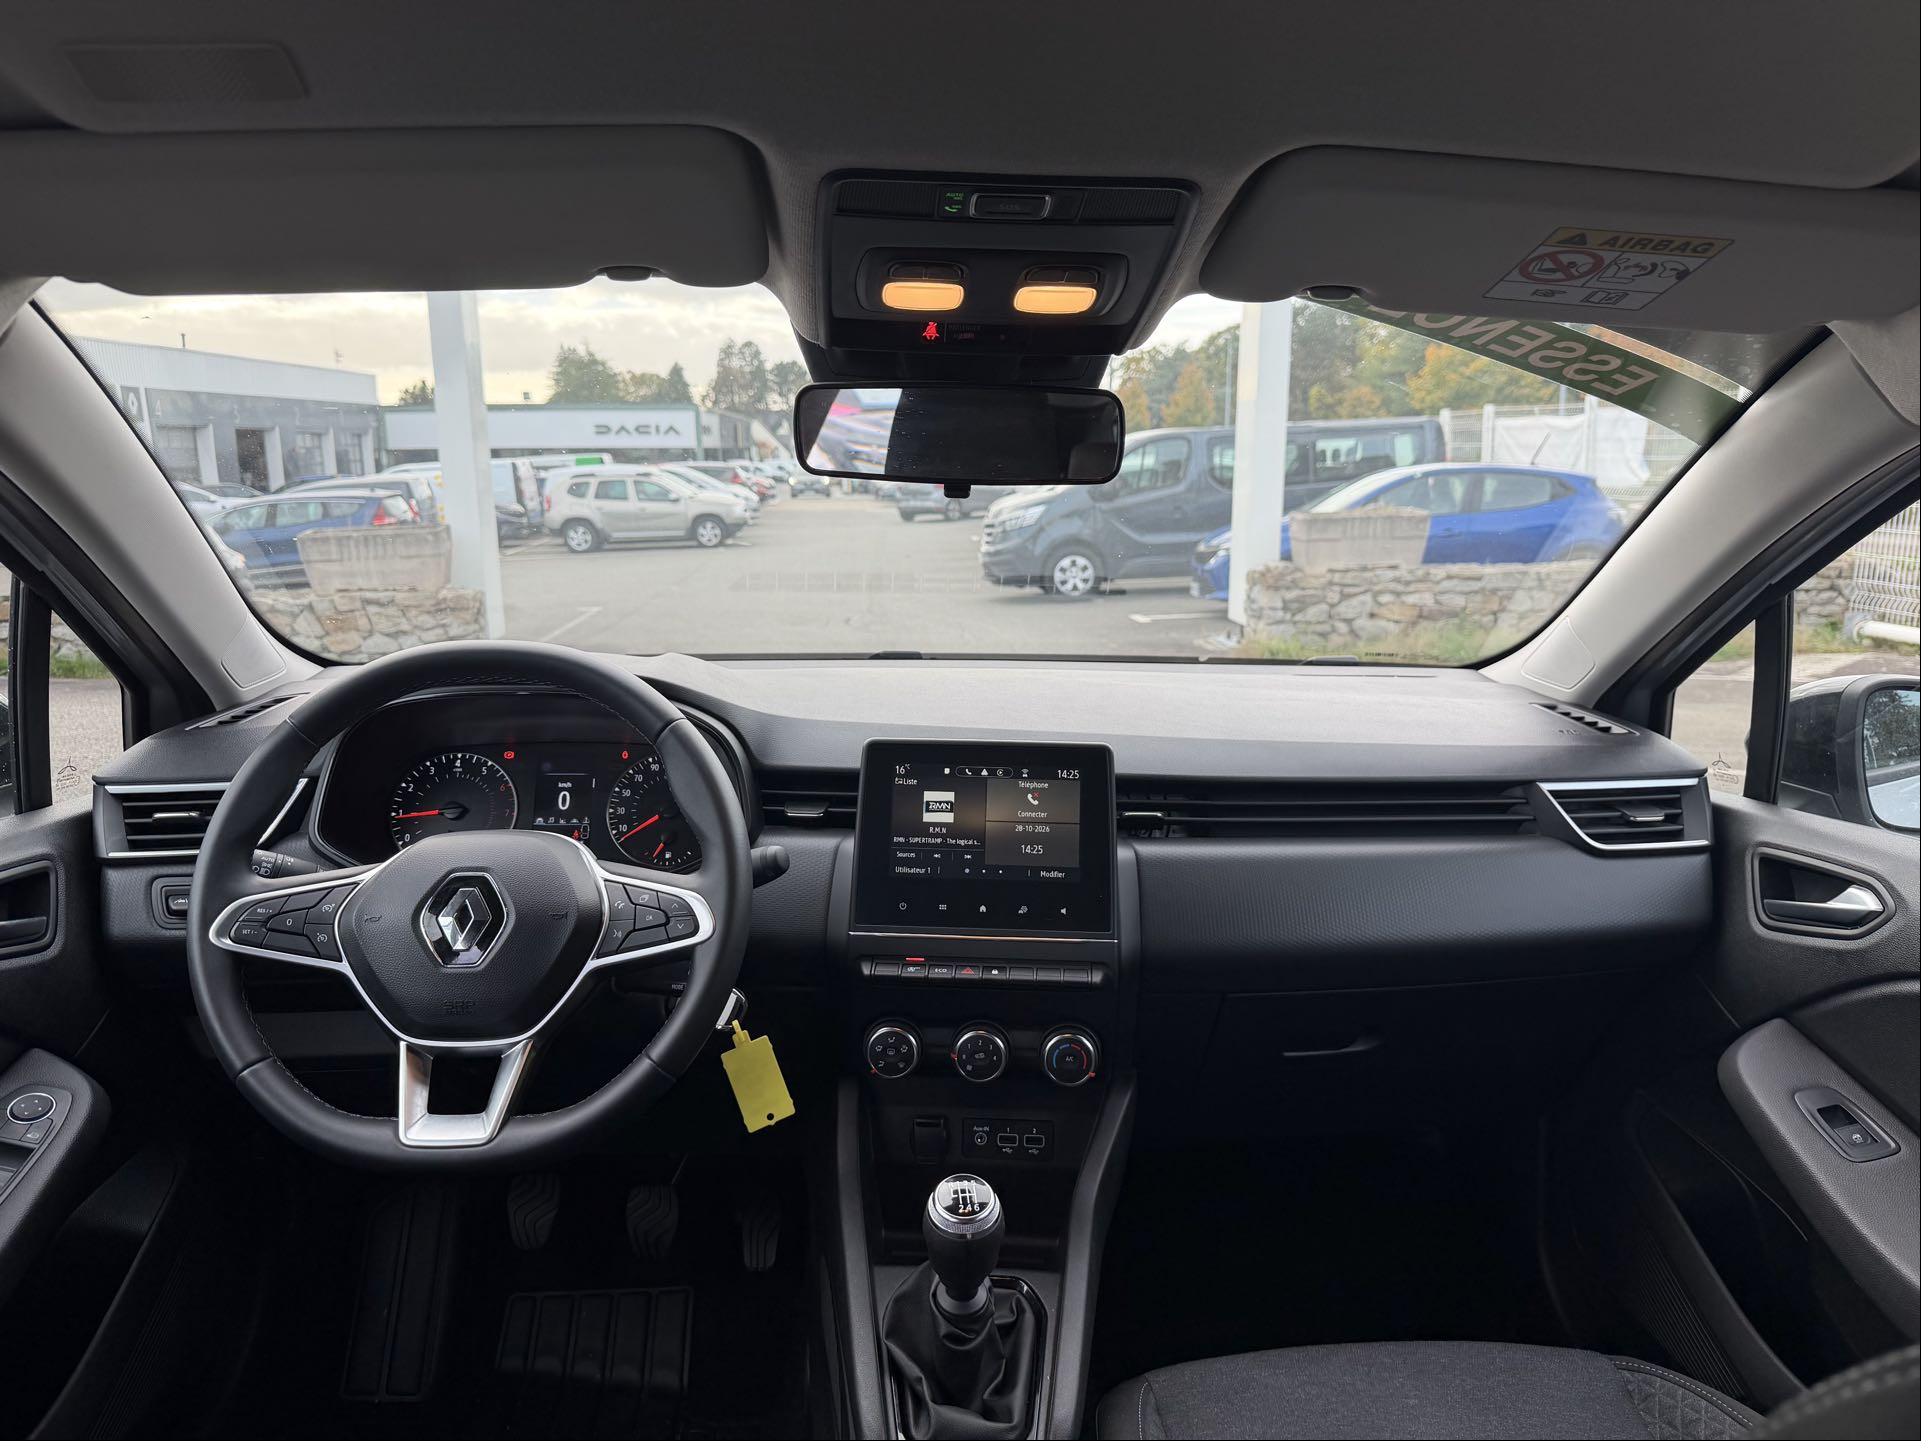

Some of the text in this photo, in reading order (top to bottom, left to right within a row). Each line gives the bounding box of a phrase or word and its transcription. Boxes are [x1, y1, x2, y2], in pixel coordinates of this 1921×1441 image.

[1597, 235, 1715, 254] AIRBAG
[593, 425, 681, 435] DACIA
[455, 759, 461, 767] 4
[481, 766, 487, 775] 5
[1057, 769, 1080, 779] 14:25
[634, 774, 643, 782] 70
[408, 783, 414, 792] 2
[1018, 780, 1049, 789] Téléphone
[558, 791, 571, 810] 0
[1017, 810, 1048, 818] Connecter
[619, 824, 628, 832] 10
[1015, 824, 1050, 833] 28-10-2026
[404, 833, 410, 842] 0
[957, 838, 973, 846] logical
[1021, 844, 1043, 854] 14:25
[1040, 870, 1066, 878] Modifier
[958, 1205, 964, 1213] 2
[974, 1203, 980, 1211] 6
